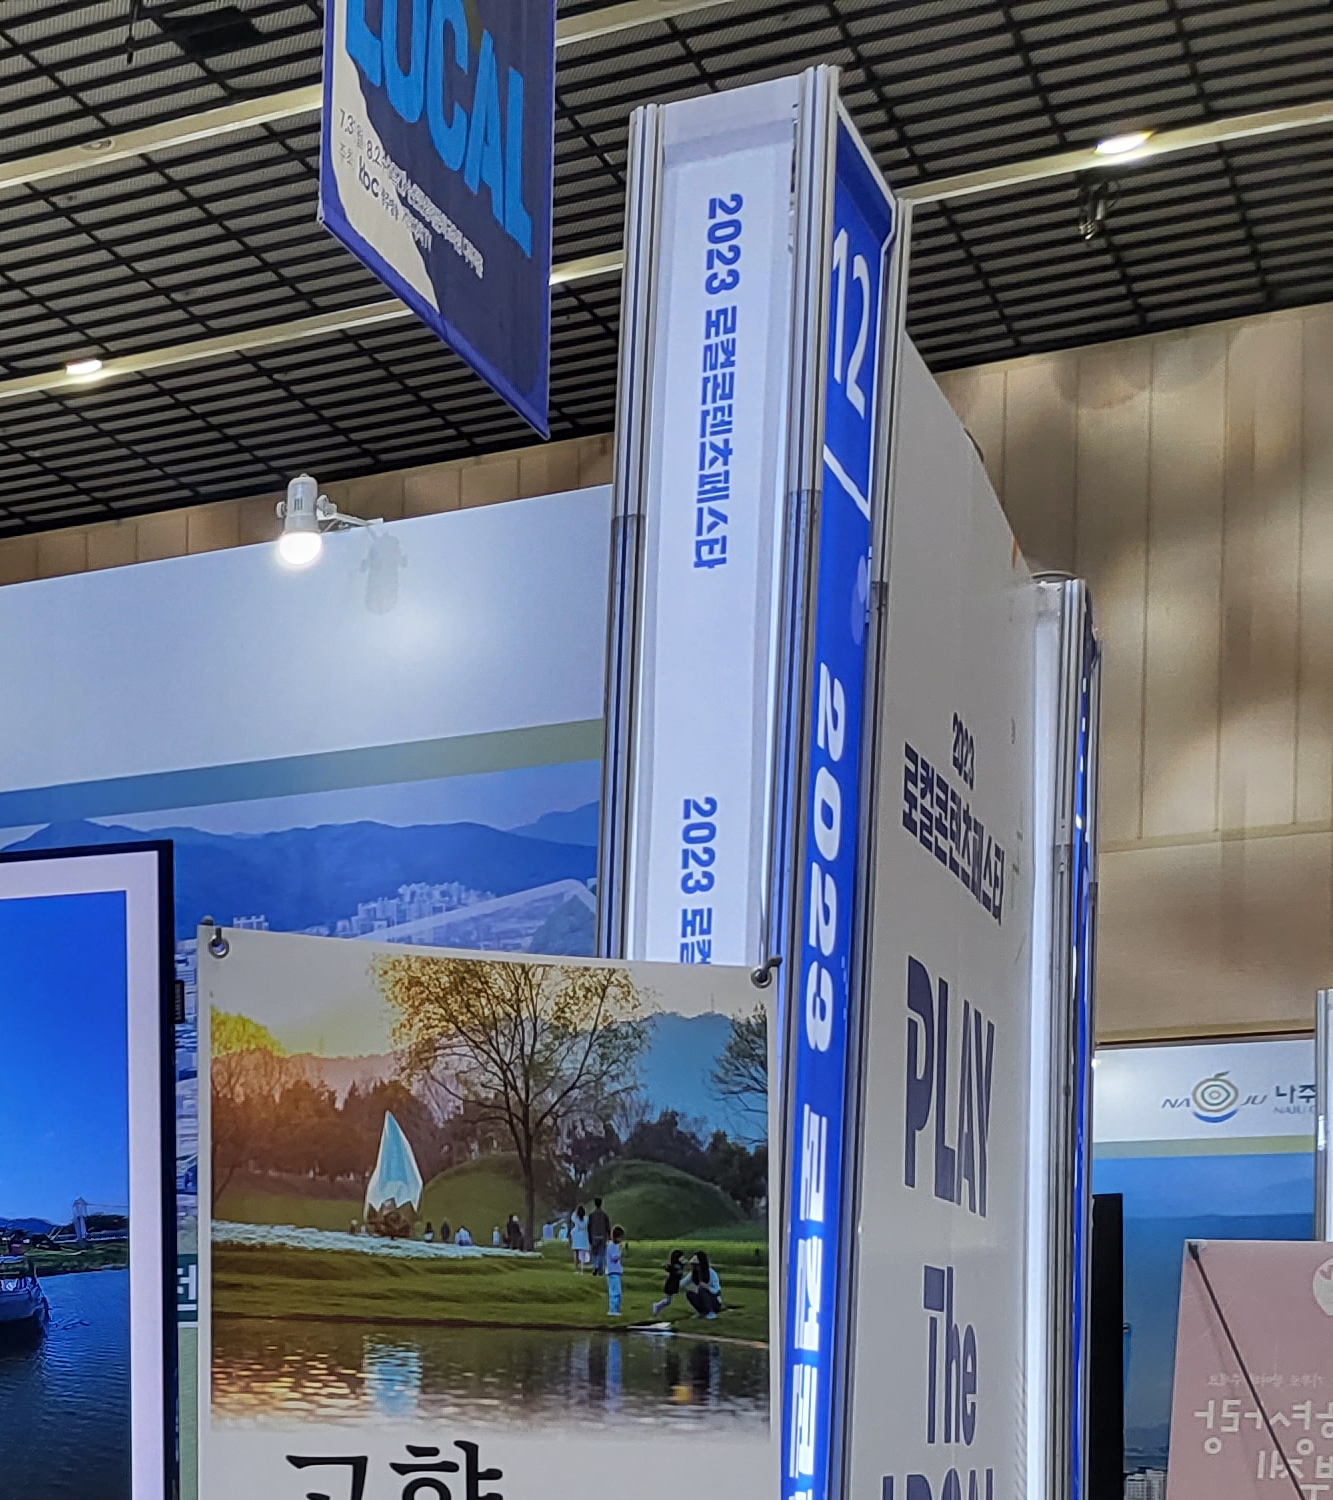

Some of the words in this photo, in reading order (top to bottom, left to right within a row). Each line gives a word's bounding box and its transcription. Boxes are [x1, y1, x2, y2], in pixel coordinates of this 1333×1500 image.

[345, 0, 531, 258] LOCAL
[705, 192, 743, 296] 2023
[832, 229, 867, 420] 12
[693, 304, 738, 570] 로컬콘텐츠페스타
[902, 741, 1005, 926] 로컬콘텐츠페스타
[952, 712, 974, 790] 2023
[681, 796, 718, 895] 2023
[805, 662, 845, 1052] 2023
[903, 953, 995, 1218] PLAY
[922, 1265, 977, 1446] The
